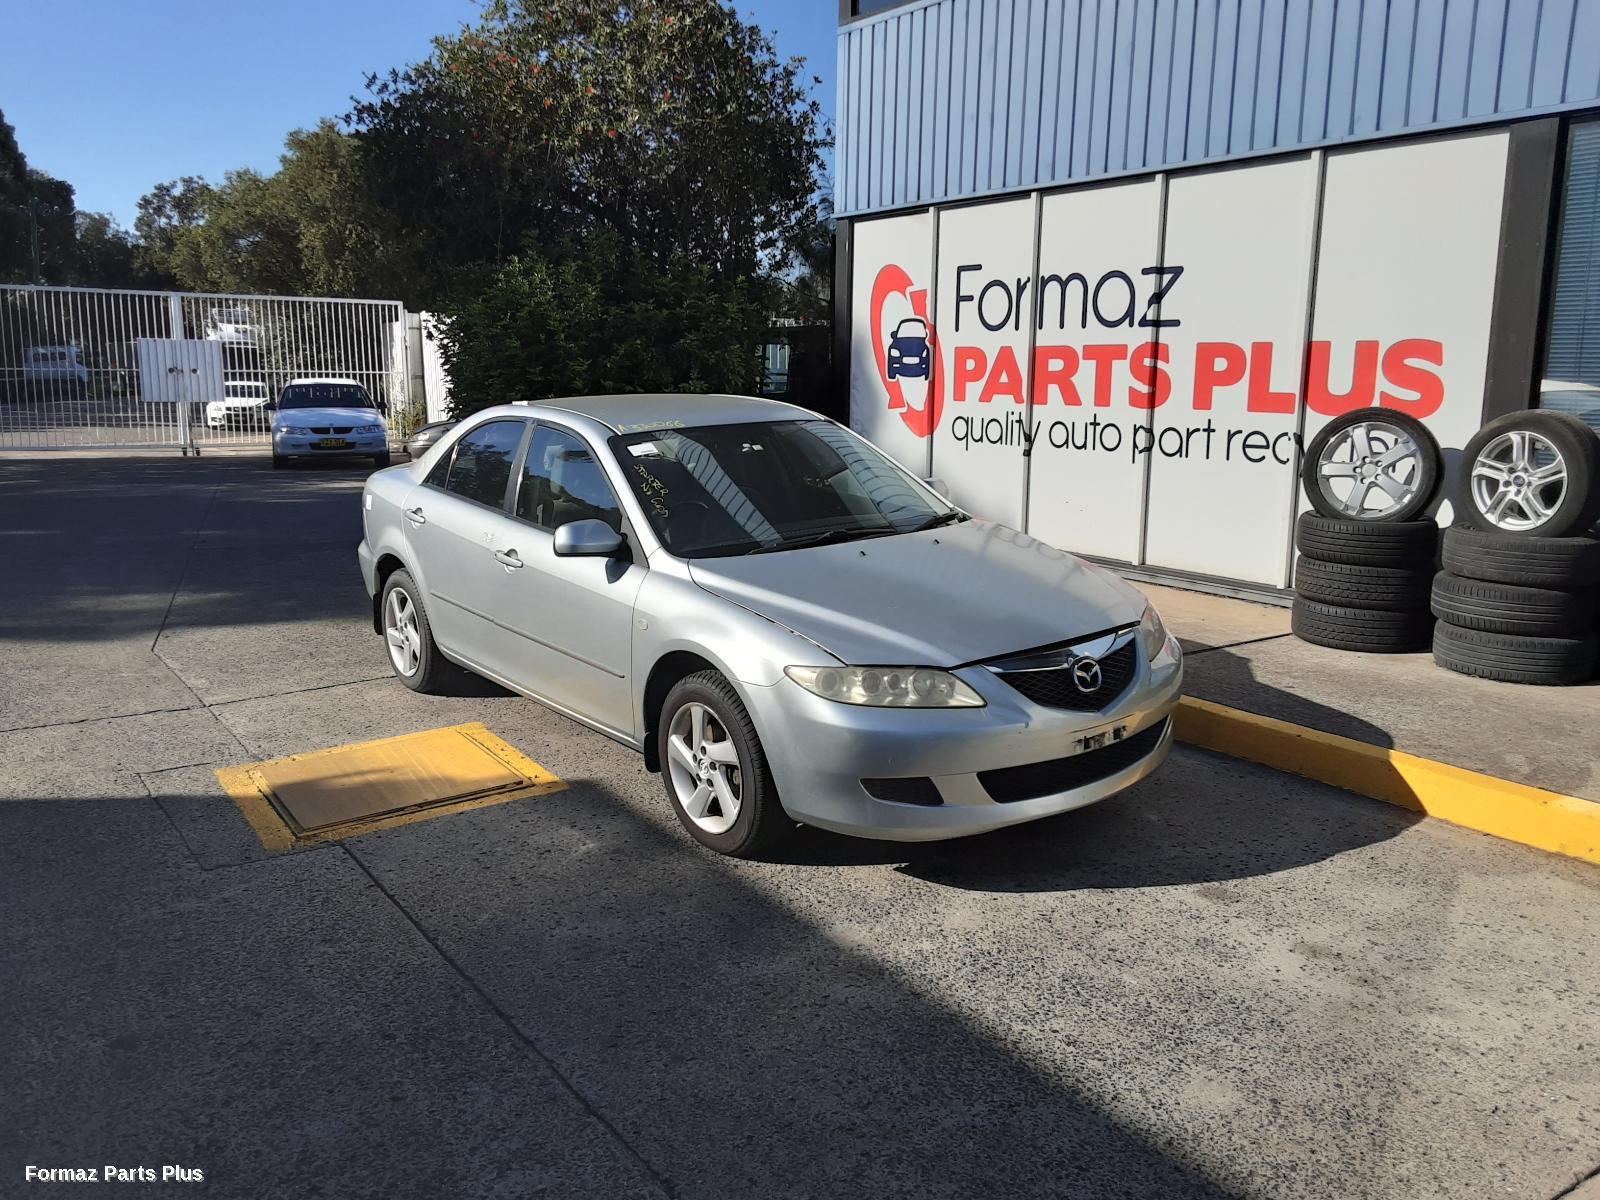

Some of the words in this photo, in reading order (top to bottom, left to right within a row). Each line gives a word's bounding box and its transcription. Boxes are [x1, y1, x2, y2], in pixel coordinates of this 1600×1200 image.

[954, 264, 1184, 332] Formaz
[953, 341, 1172, 409] PARTS
[1193, 338, 1444, 420] PLUS
[952, 411, 1041, 456] quality
[1049, 413, 1122, 451] auto
[1132, 419, 1216, 464] part
